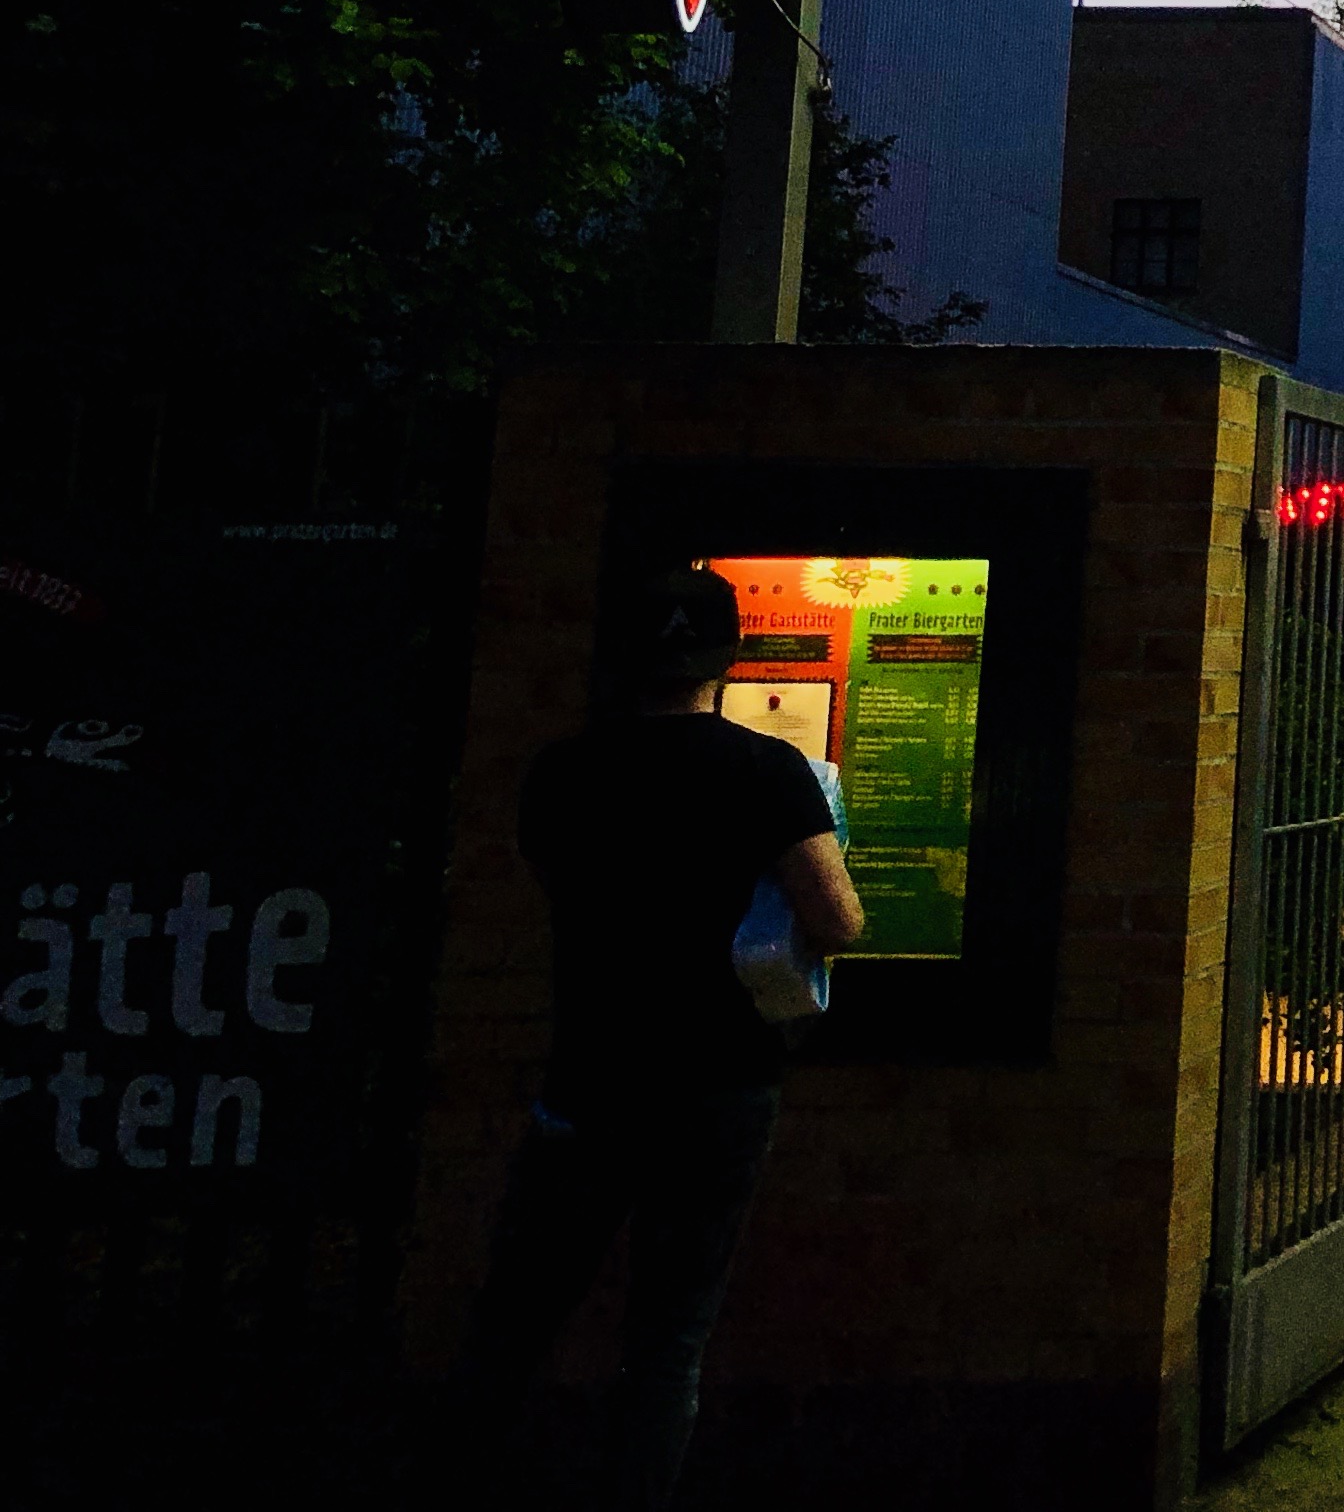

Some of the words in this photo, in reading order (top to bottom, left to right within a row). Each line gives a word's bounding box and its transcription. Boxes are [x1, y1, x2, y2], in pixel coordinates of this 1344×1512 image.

[771, 610, 836, 629] Gaststätte
[869, 611, 909, 630] Prater
[914, 611, 983, 632] Biergarten
